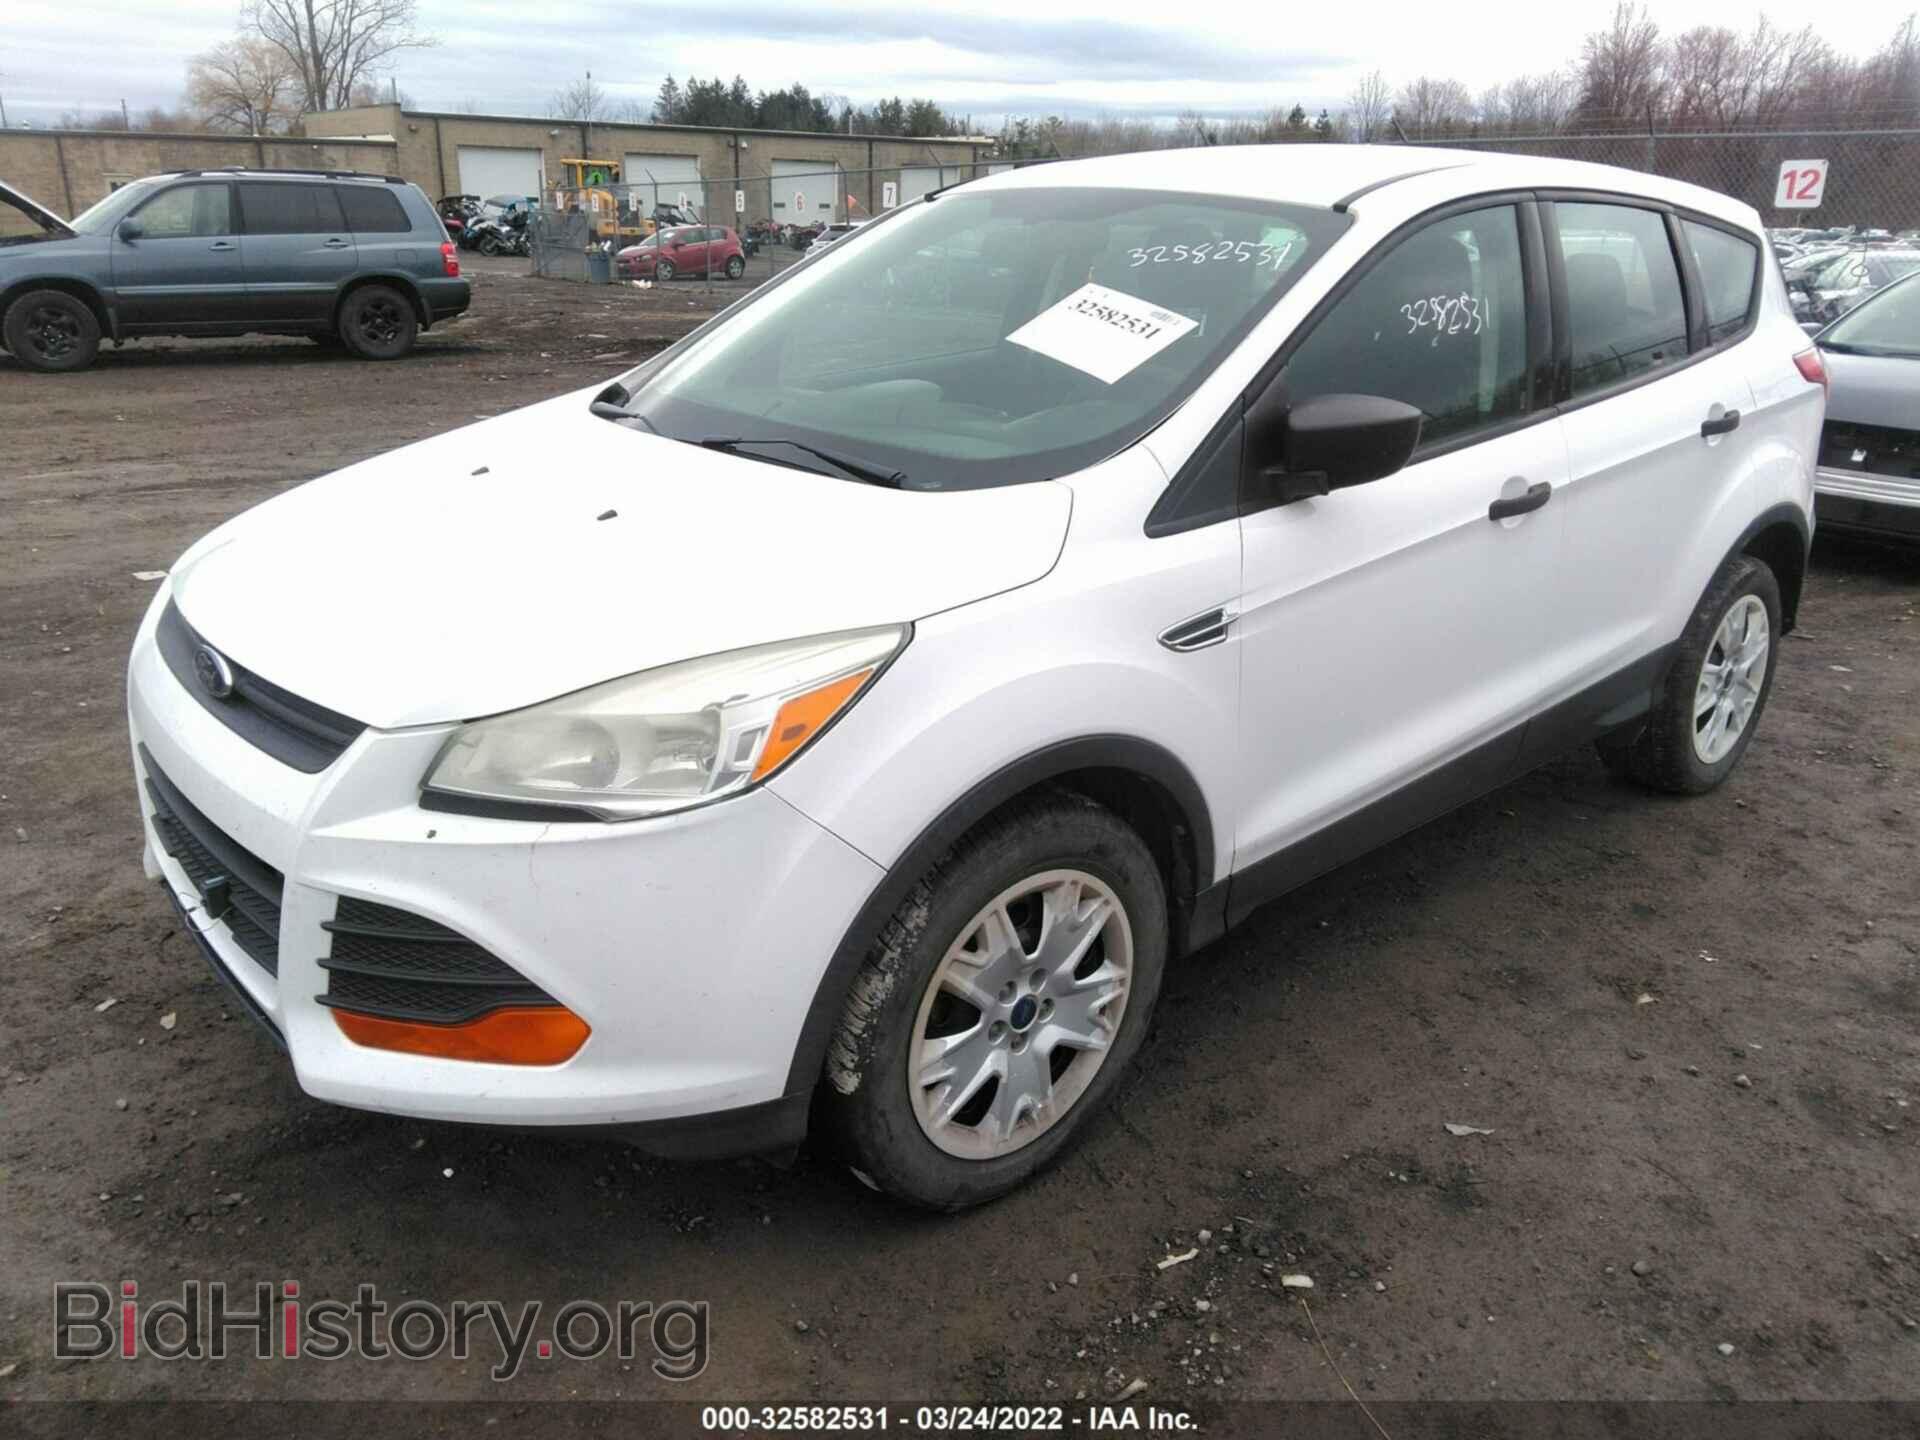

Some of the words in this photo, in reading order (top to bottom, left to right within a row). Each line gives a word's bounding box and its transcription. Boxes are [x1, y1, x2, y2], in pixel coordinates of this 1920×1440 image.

[886, 187, 894, 203] 7
[1783, 169, 1821, 200] 12
[1128, 241, 1292, 269] 32582531
[1068, 299, 1161, 339] 32582531
[1400, 291, 1490, 335] 32582531
